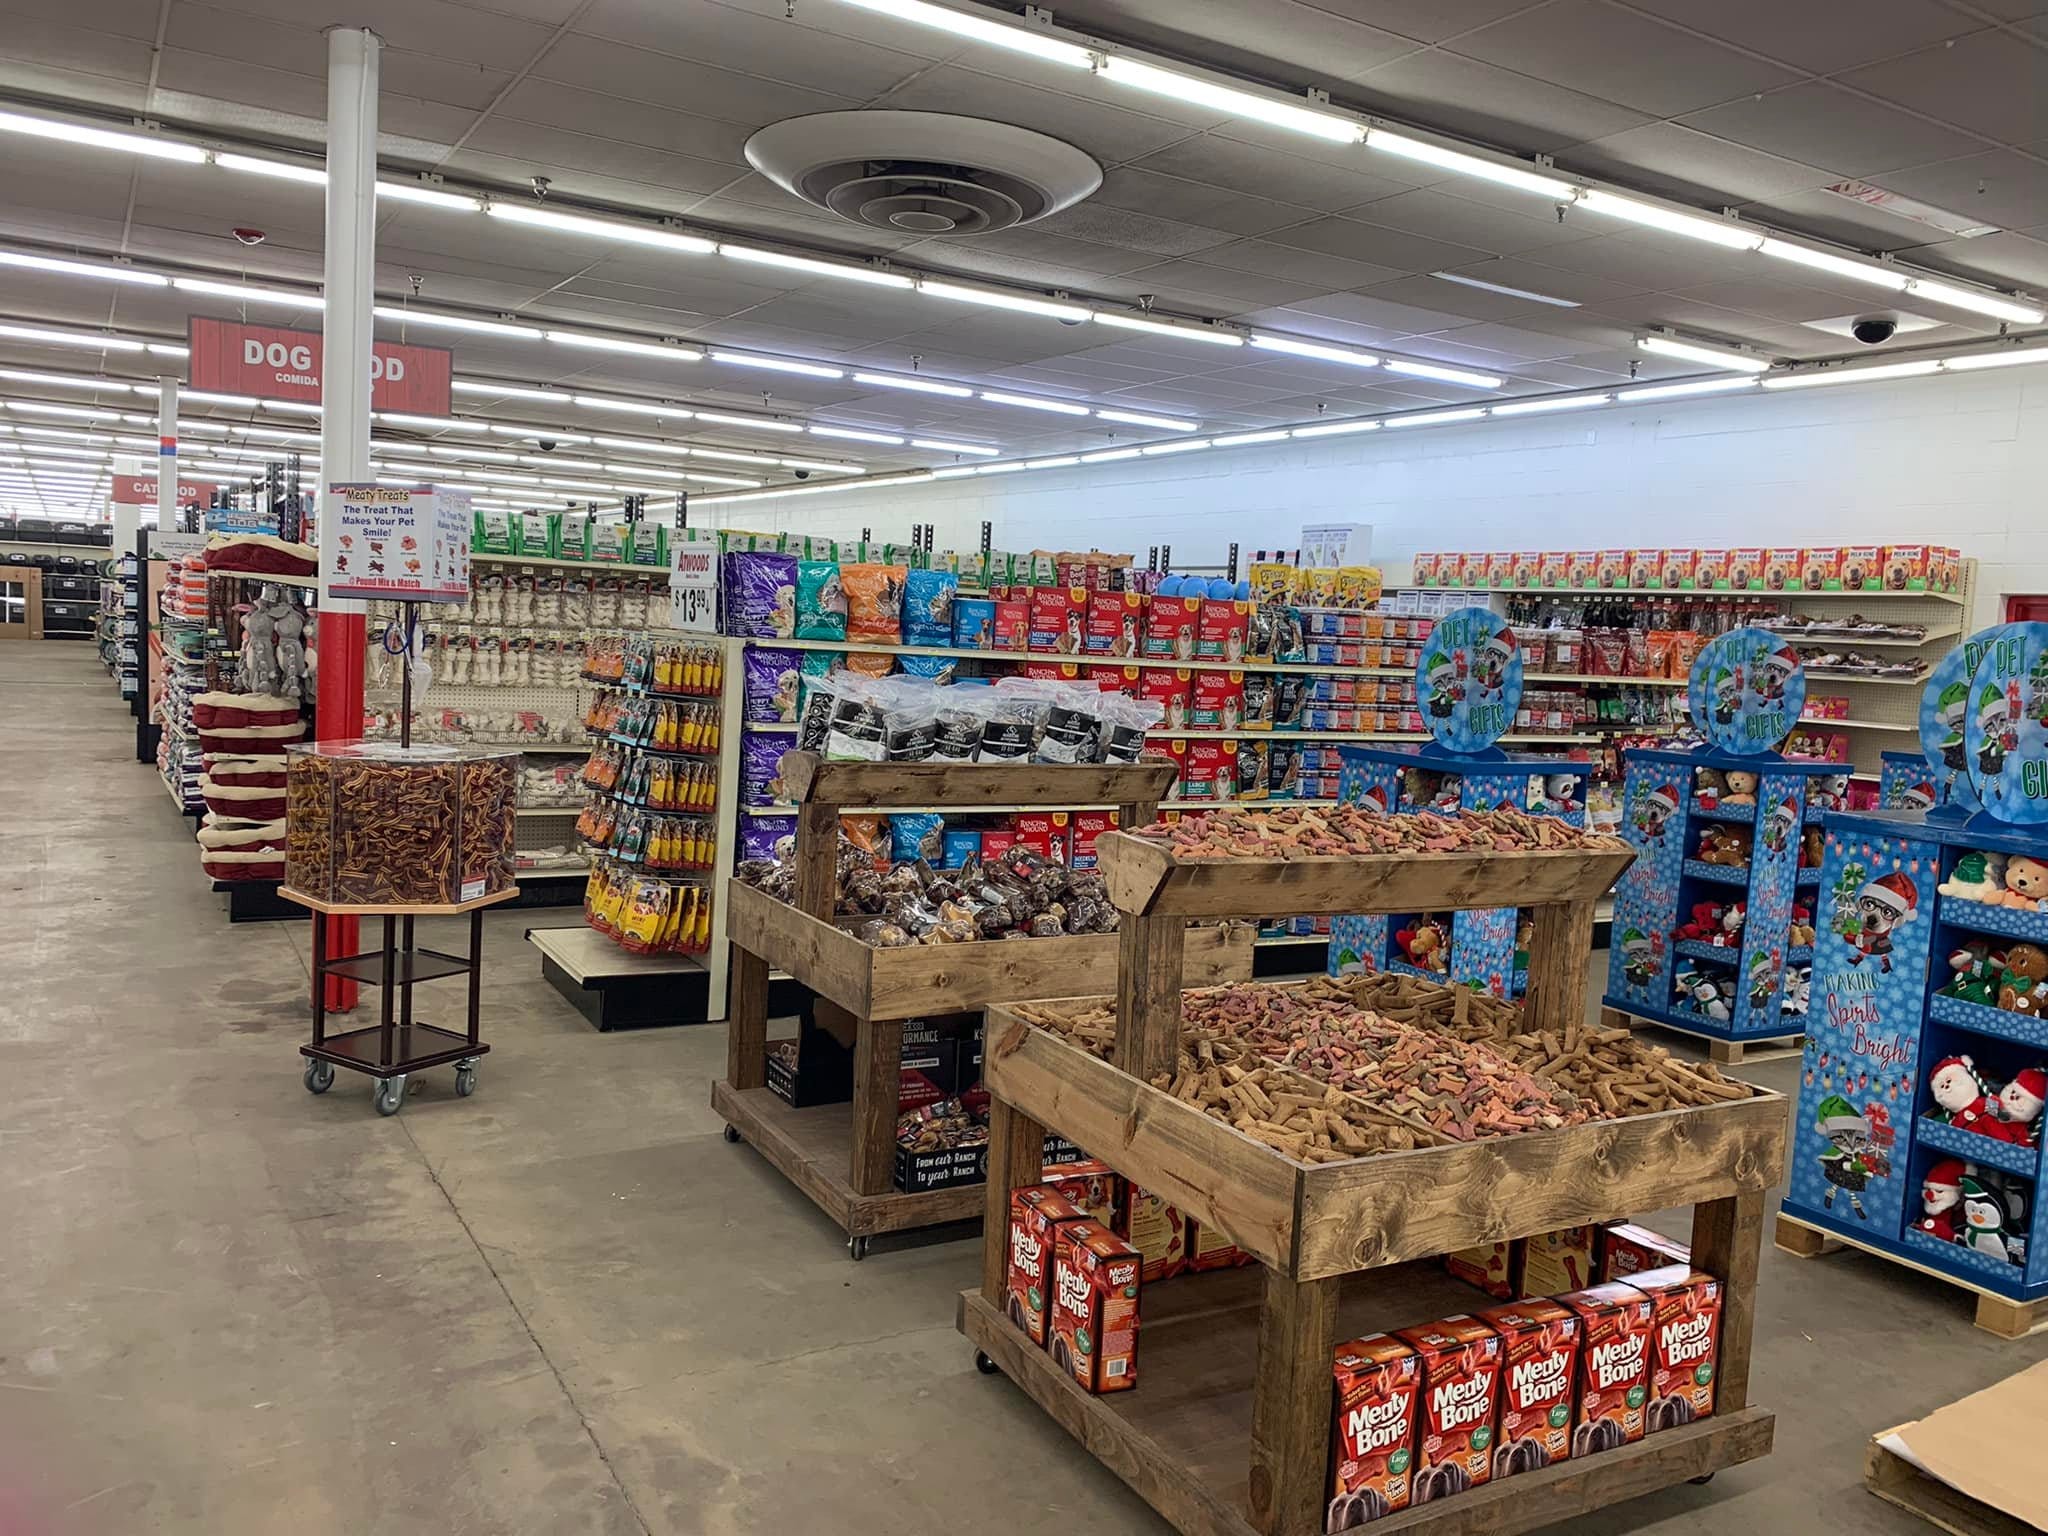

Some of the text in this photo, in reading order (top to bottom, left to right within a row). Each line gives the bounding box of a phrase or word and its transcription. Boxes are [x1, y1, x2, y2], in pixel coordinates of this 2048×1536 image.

[244, 339, 311, 370] DOG
[275, 373, 319, 386] COMIDA
[133, 482, 158, 494] CAT
[346, 489, 409, 504] Meaty Treats
[342, 516, 415, 526] Makes Your Pet
[344, 505, 413, 515] The Treat That
[362, 528, 391, 537] Smile!
[397, 579, 420, 588] Match
[1441, 618, 1470, 649] PET
[1726, 638, 1748, 664] PET
[1996, 636, 2027, 680] PET
[1469, 704, 1505, 736] GIFTS
[1745, 712, 1786, 740] GIFTS
[1824, 972, 1880, 993] MAKING
[903, 1031, 938, 1044] ORMANCE
[1849, 1024, 1916, 1072] Bright
[928, 1171, 949, 1186] your
[1012, 1222, 1041, 1261] Meaty
[1616, 1249, 1639, 1264] Meaty
[1014, 1245, 1040, 1278] Bone
[1109, 1264, 1135, 1279] Meaty
[1056, 1260, 1091, 1301] Meaty
[1112, 1274, 1134, 1286] Bone
[1060, 1284, 1089, 1318] Bone
[1661, 1311, 1712, 1349] Meaty
[1592, 1333, 1646, 1370] Meaty
[1668, 1336, 1711, 1366] Bone
[1512, 1350, 1569, 1390] Meaty
[1600, 1357, 1643, 1389] Bone
[1433, 1370, 1492, 1413] Meaty
[1520, 1374, 1567, 1409] Bone
[1348, 1391, 1410, 1437] Meaty
[1441, 1396, 1489, 1432] Bone
[1551, 1408, 1568, 1419] Large
[1356, 1418, 1408, 1457] Bone
[1473, 1430, 1490, 1441] Large
[1391, 1453, 1409, 1464] Large
